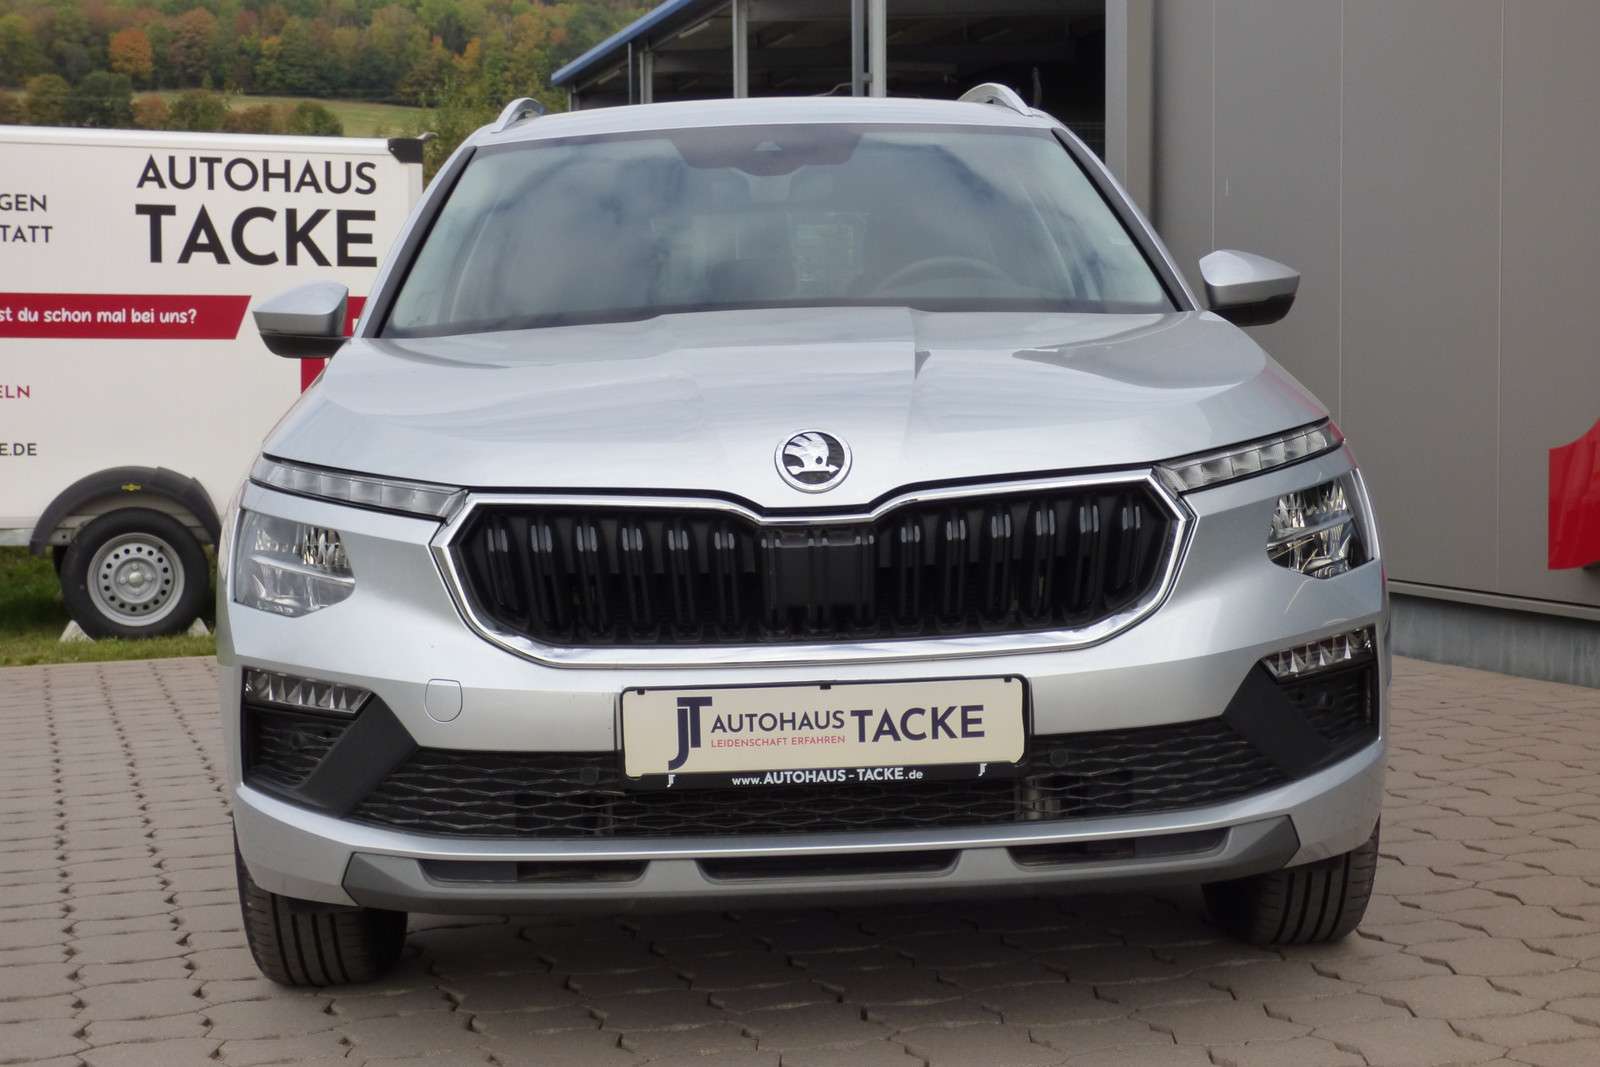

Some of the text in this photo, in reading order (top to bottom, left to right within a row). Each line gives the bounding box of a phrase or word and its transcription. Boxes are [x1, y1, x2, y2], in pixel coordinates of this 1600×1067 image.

[136, 154, 377, 195] AUTOHAUS
[135, 203, 378, 268] TACKE
[17, 307, 39, 322] du
[43, 307, 92, 323] schon
[96, 308, 126, 323] mal
[131, 308, 155, 323] bei
[159, 308, 198, 324] uns?
[710, 704, 985, 743] AUTOHAUS TACKE
[711, 735, 846, 749] LEIDENSCHAFT ERFAHREN
